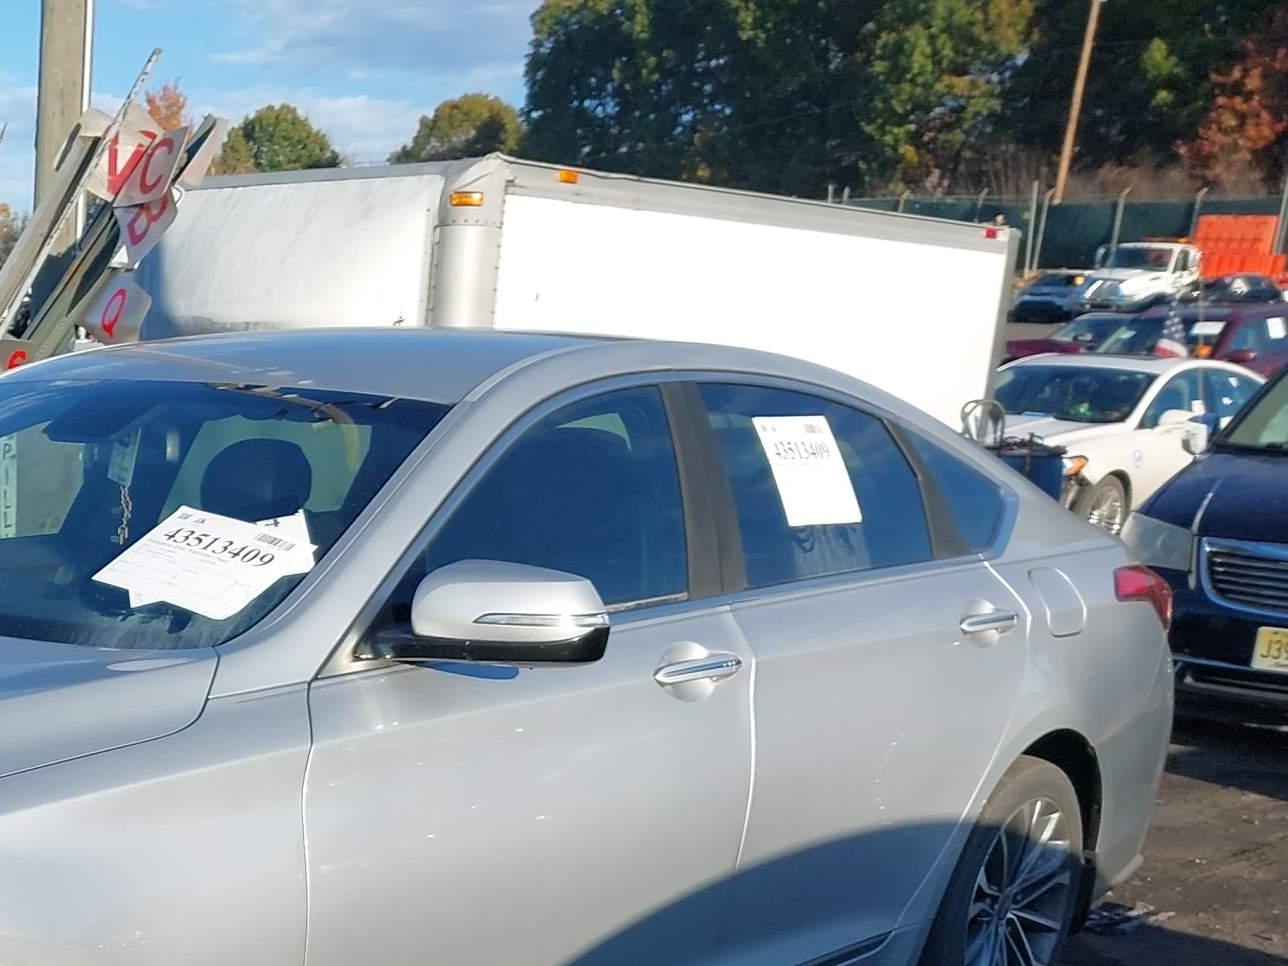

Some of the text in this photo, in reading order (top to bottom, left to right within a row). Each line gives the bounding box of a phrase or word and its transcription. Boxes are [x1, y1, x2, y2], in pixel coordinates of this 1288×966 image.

[140, 137, 175, 196] C
[102, 288, 127, 337] Q
[164, 527, 276, 567] 43513409
